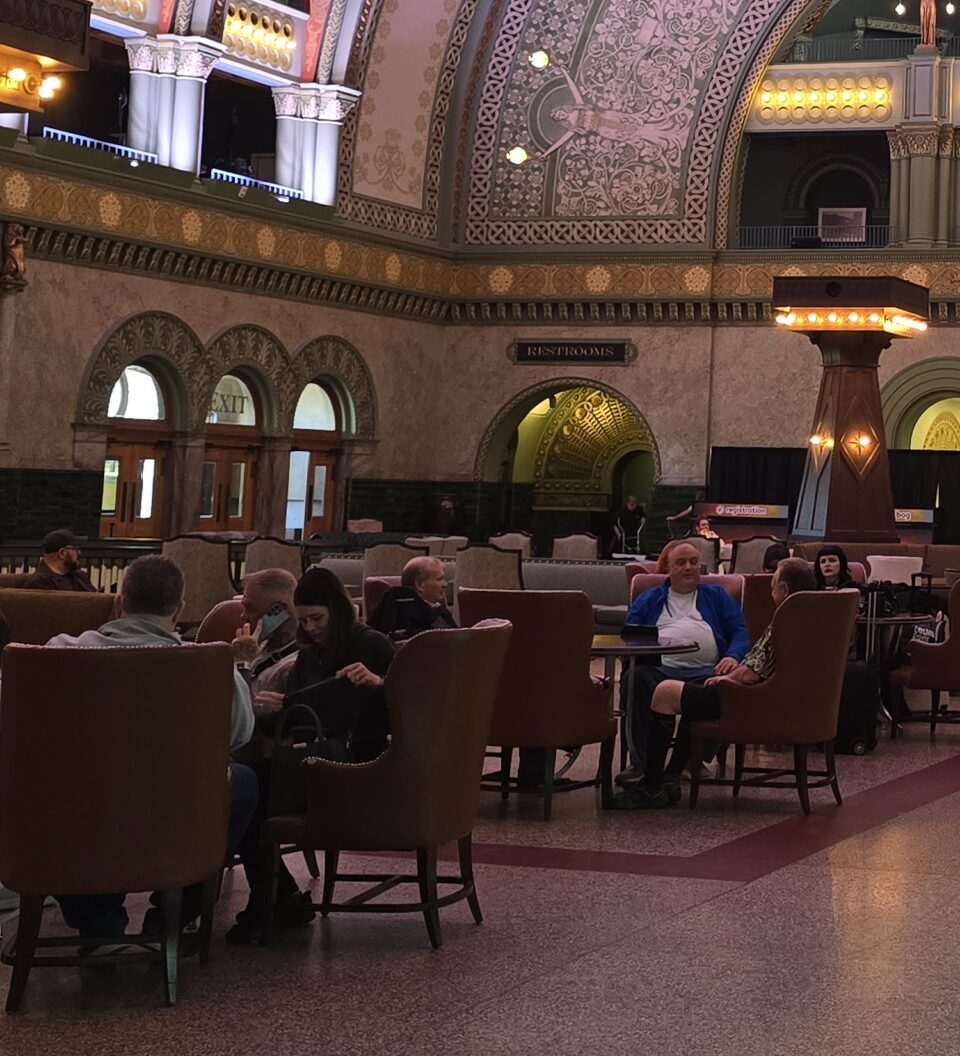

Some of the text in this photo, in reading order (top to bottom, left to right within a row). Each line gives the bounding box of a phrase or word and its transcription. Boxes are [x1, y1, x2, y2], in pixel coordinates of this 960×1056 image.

[526, 345, 616, 357] RESTROOMS
[209, 391, 249, 414] EXIT
[726, 506, 766, 516] registration
[896, 511, 911, 520] bag
